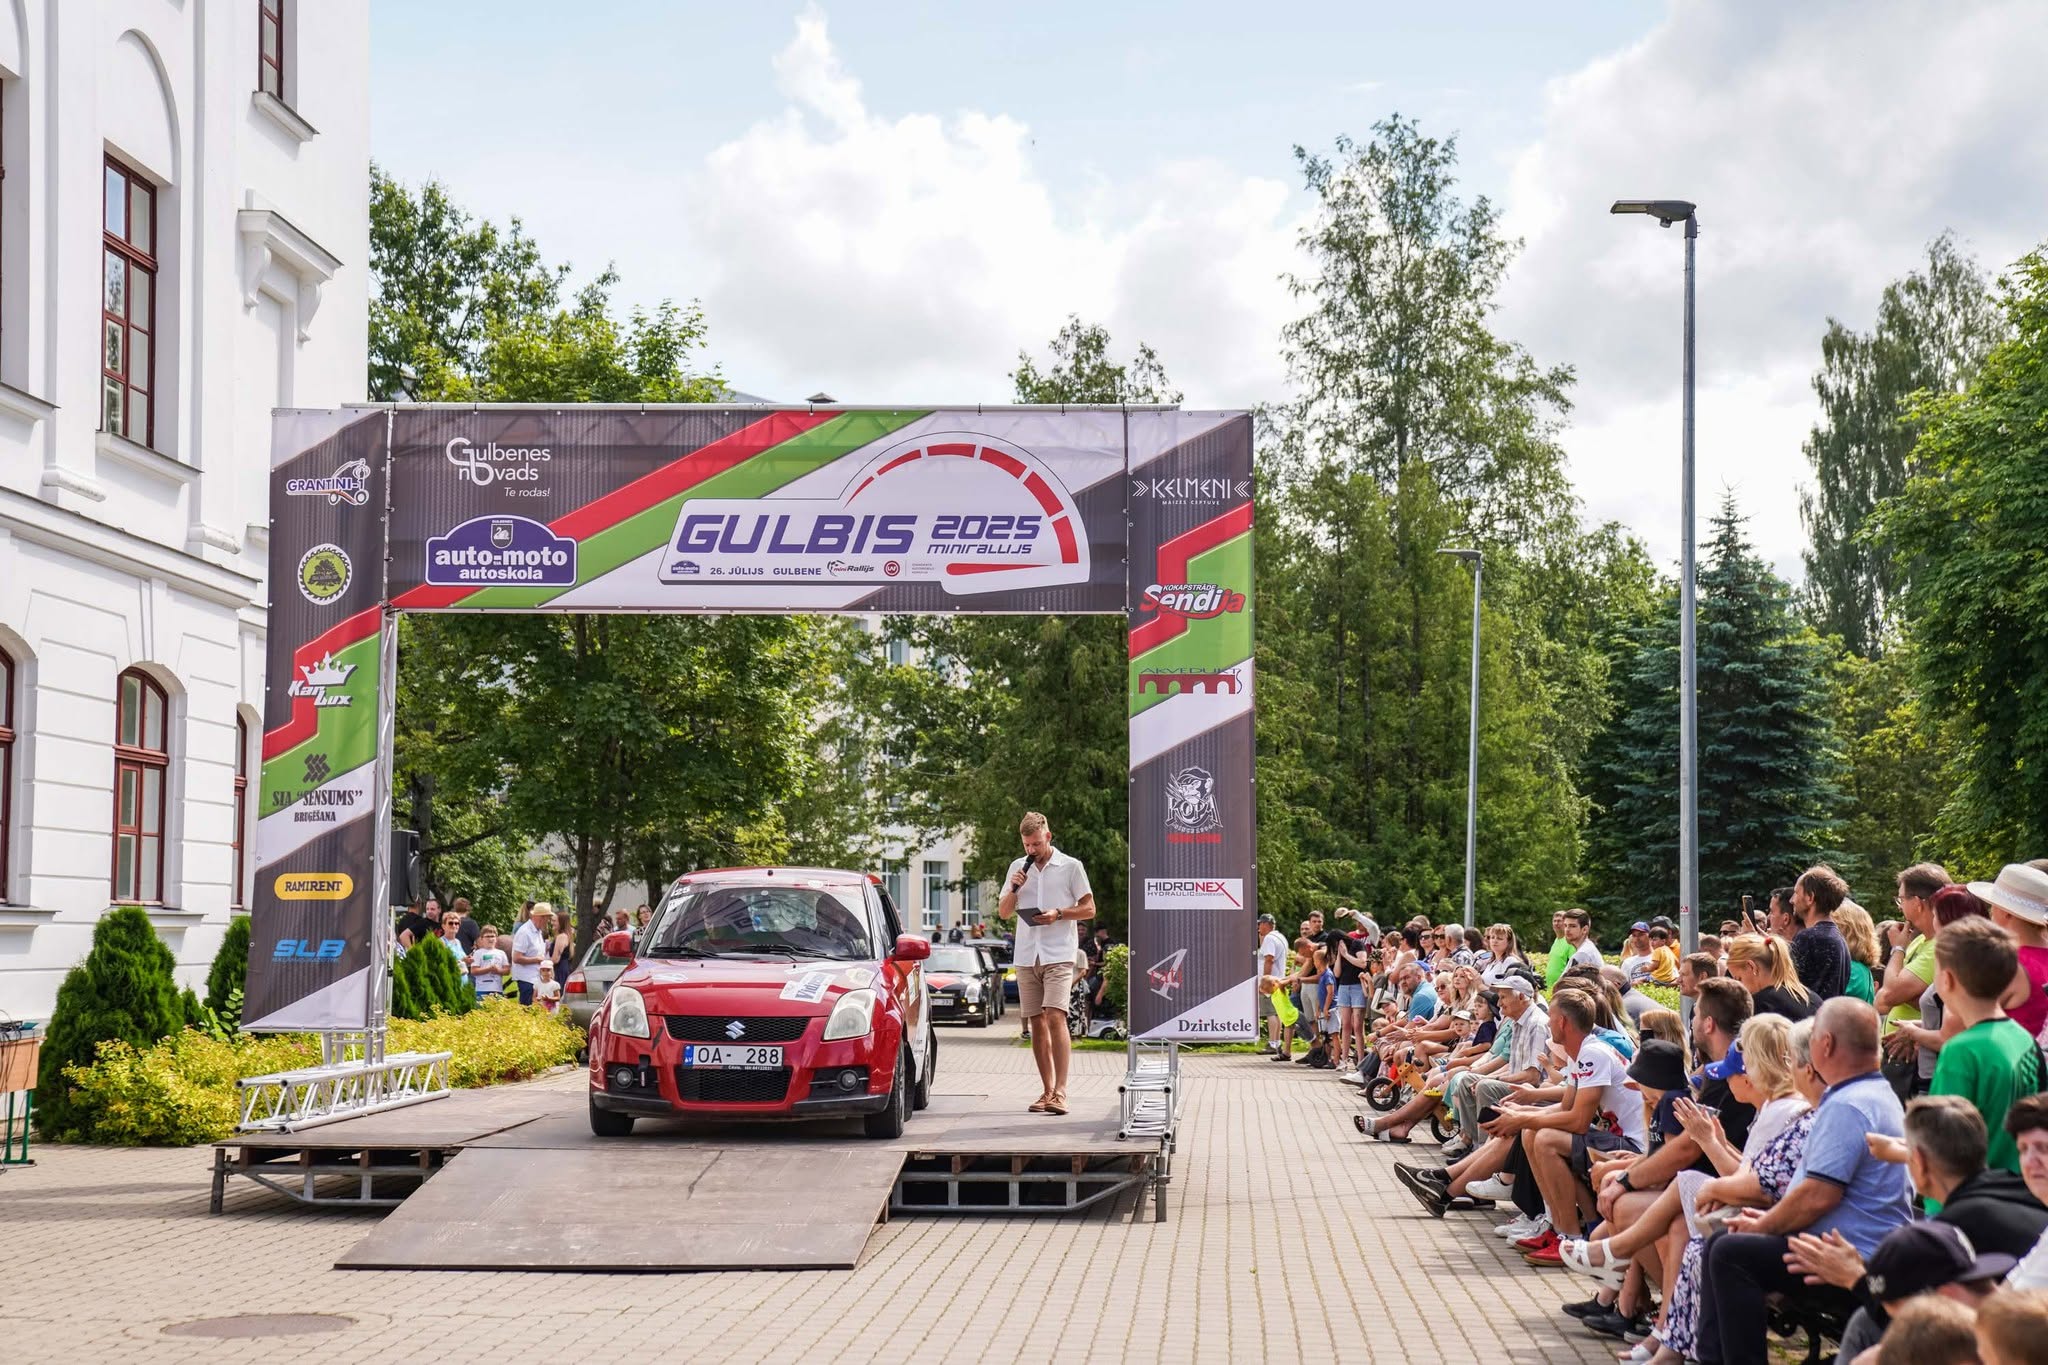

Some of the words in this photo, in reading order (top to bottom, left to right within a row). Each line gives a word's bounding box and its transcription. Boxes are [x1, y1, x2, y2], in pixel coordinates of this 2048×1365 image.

[446, 437, 551, 465] Gulbenes
[458, 462, 539, 486] novads
[287, 478, 364, 491] GRANTINI-1
[504, 487, 516, 497] Te
[518, 487, 551, 498] rodas!
[676, 514, 918, 554] GULBIS
[931, 515, 1042, 540] 2025
[434, 546, 568, 566] auto-moto
[459, 567, 543, 580] autoskola
[773, 568, 822, 576] GULBENE
[1139, 584, 1246, 617] Sendija
[272, 790, 292, 807] SIA
[285, 881, 342, 892] RAMIRENT
[1148, 881, 1232, 899] HIDRONEX
[274, 939, 346, 957] SLB
[1178, 1019, 1252, 1032] Dzirkstele
[746, 1048, 779, 1064] 288
